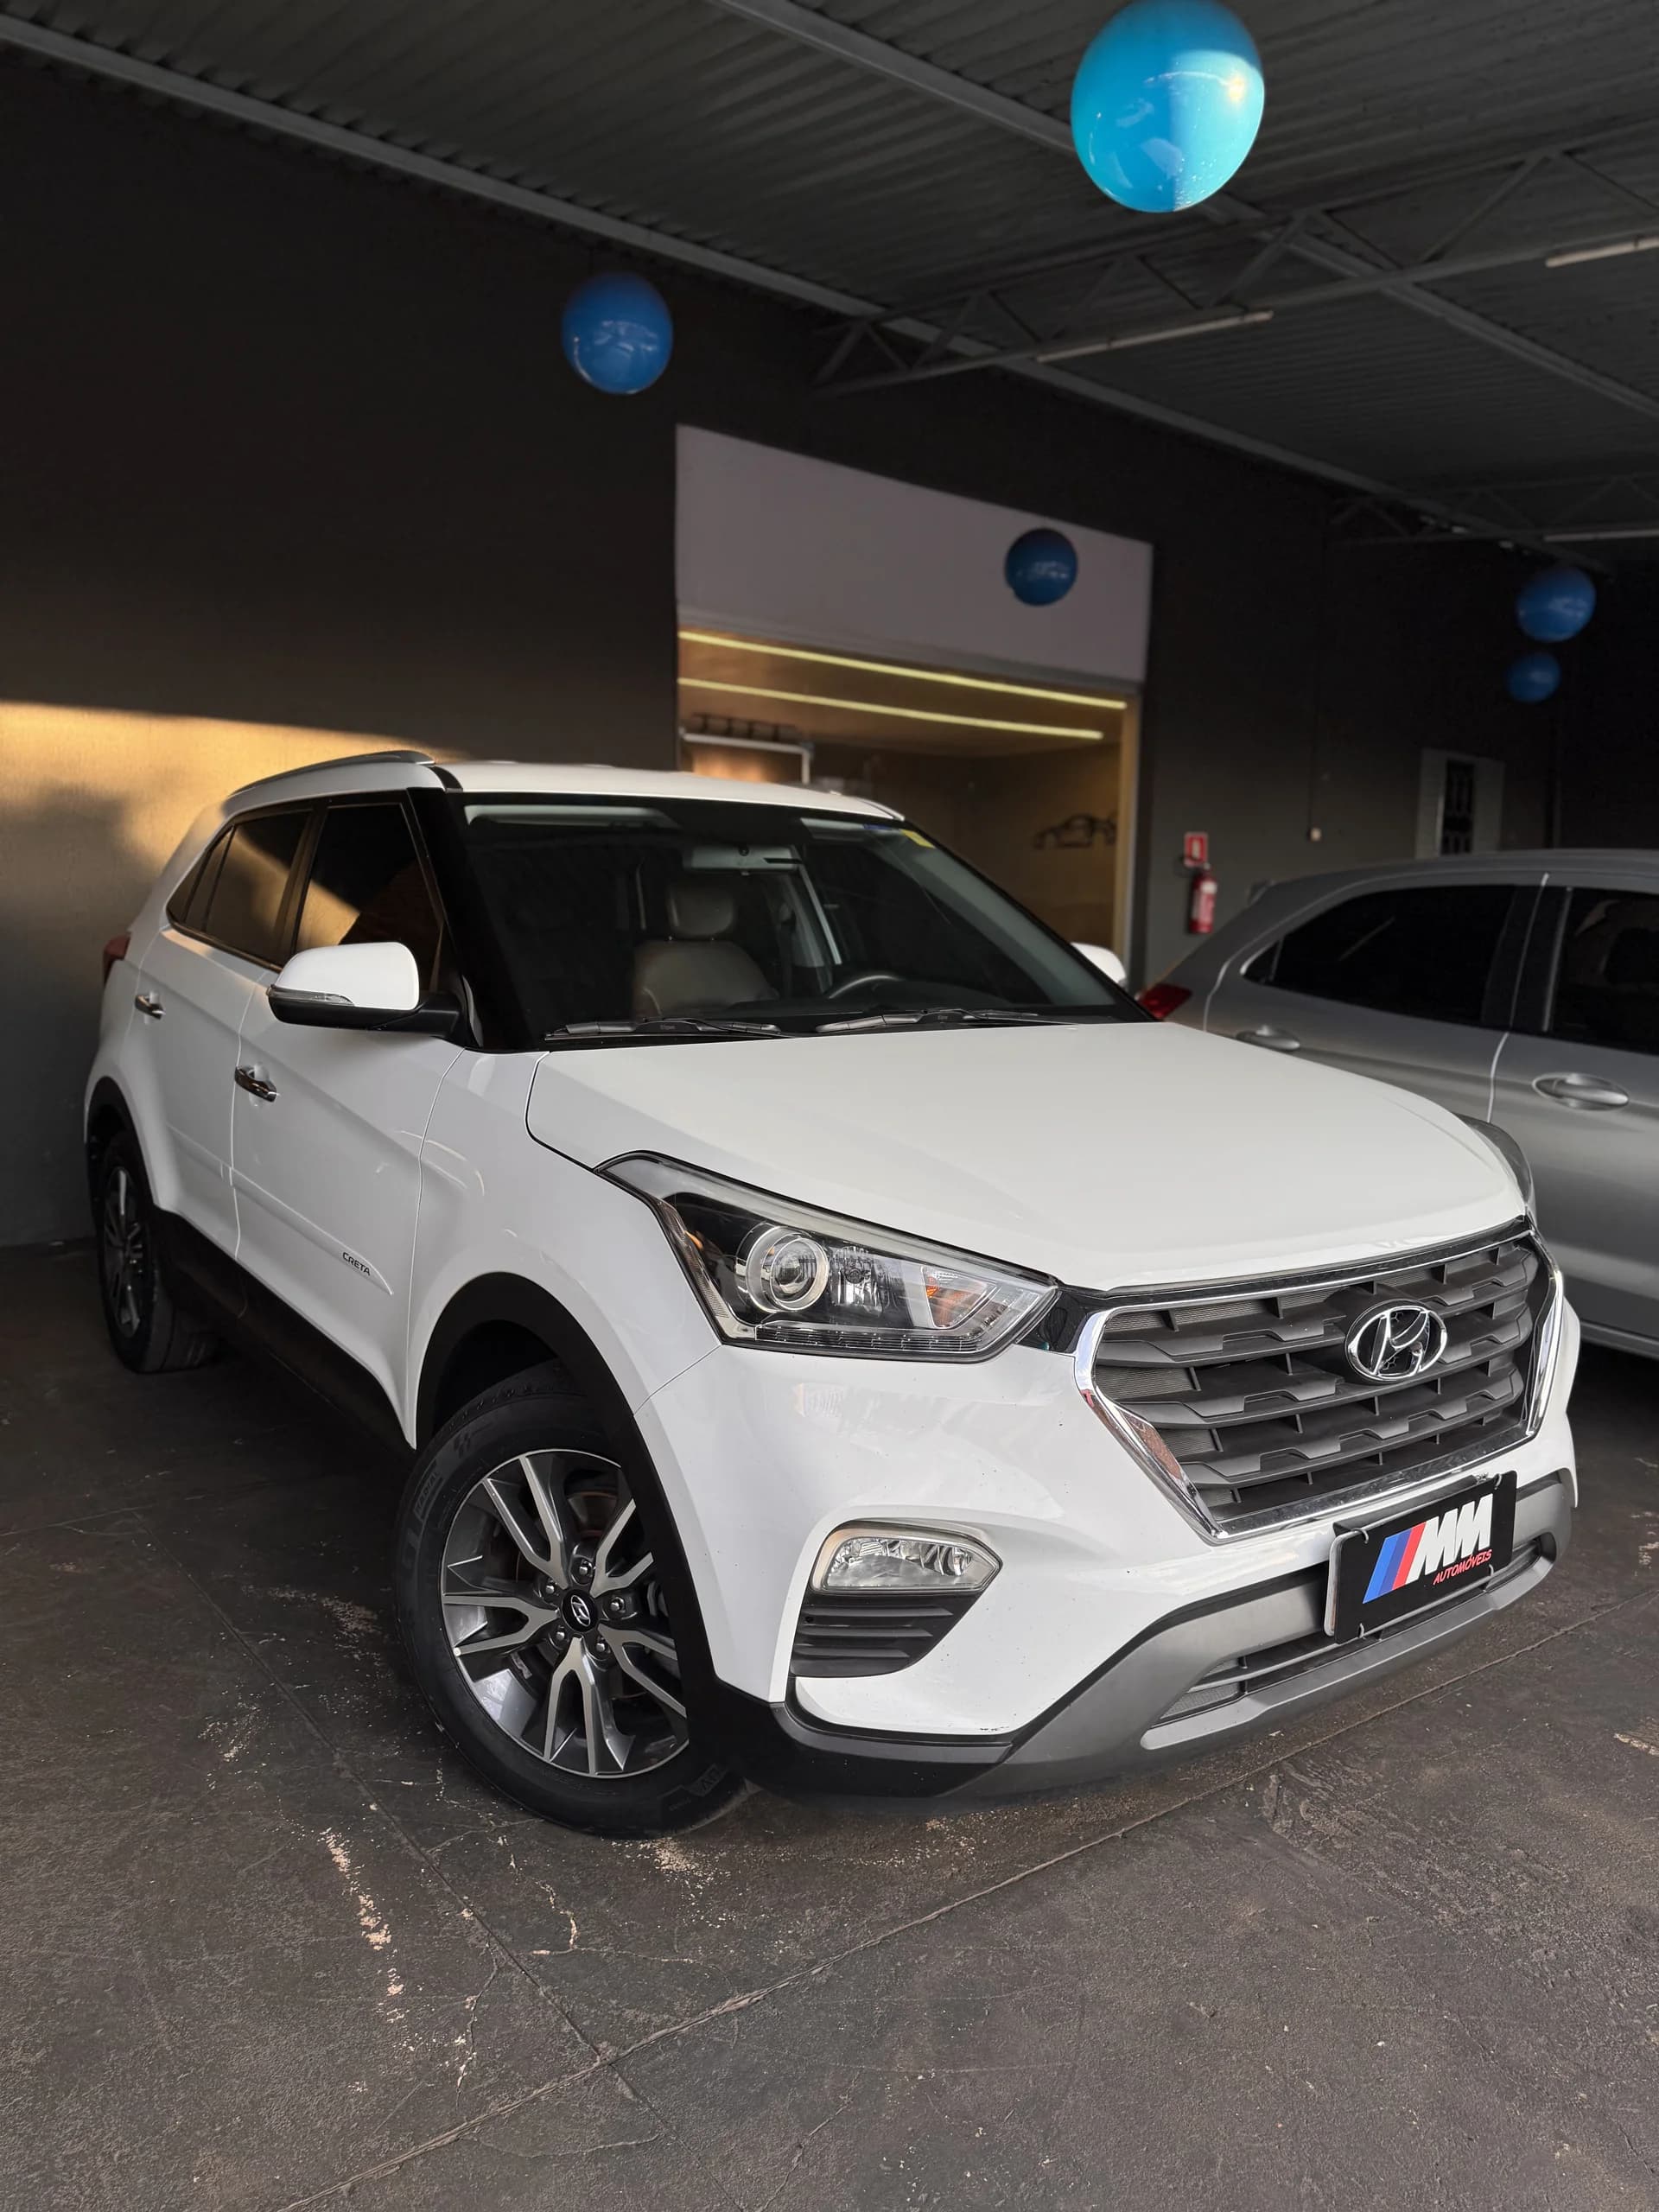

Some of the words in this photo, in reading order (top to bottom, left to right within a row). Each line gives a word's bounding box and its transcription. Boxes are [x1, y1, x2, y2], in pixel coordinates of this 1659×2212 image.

[342, 1252, 371, 1276] CRETA
[1405, 1493, 1493, 1585] MM
[1433, 1549, 1493, 1586] AUTOMÓVEIS
